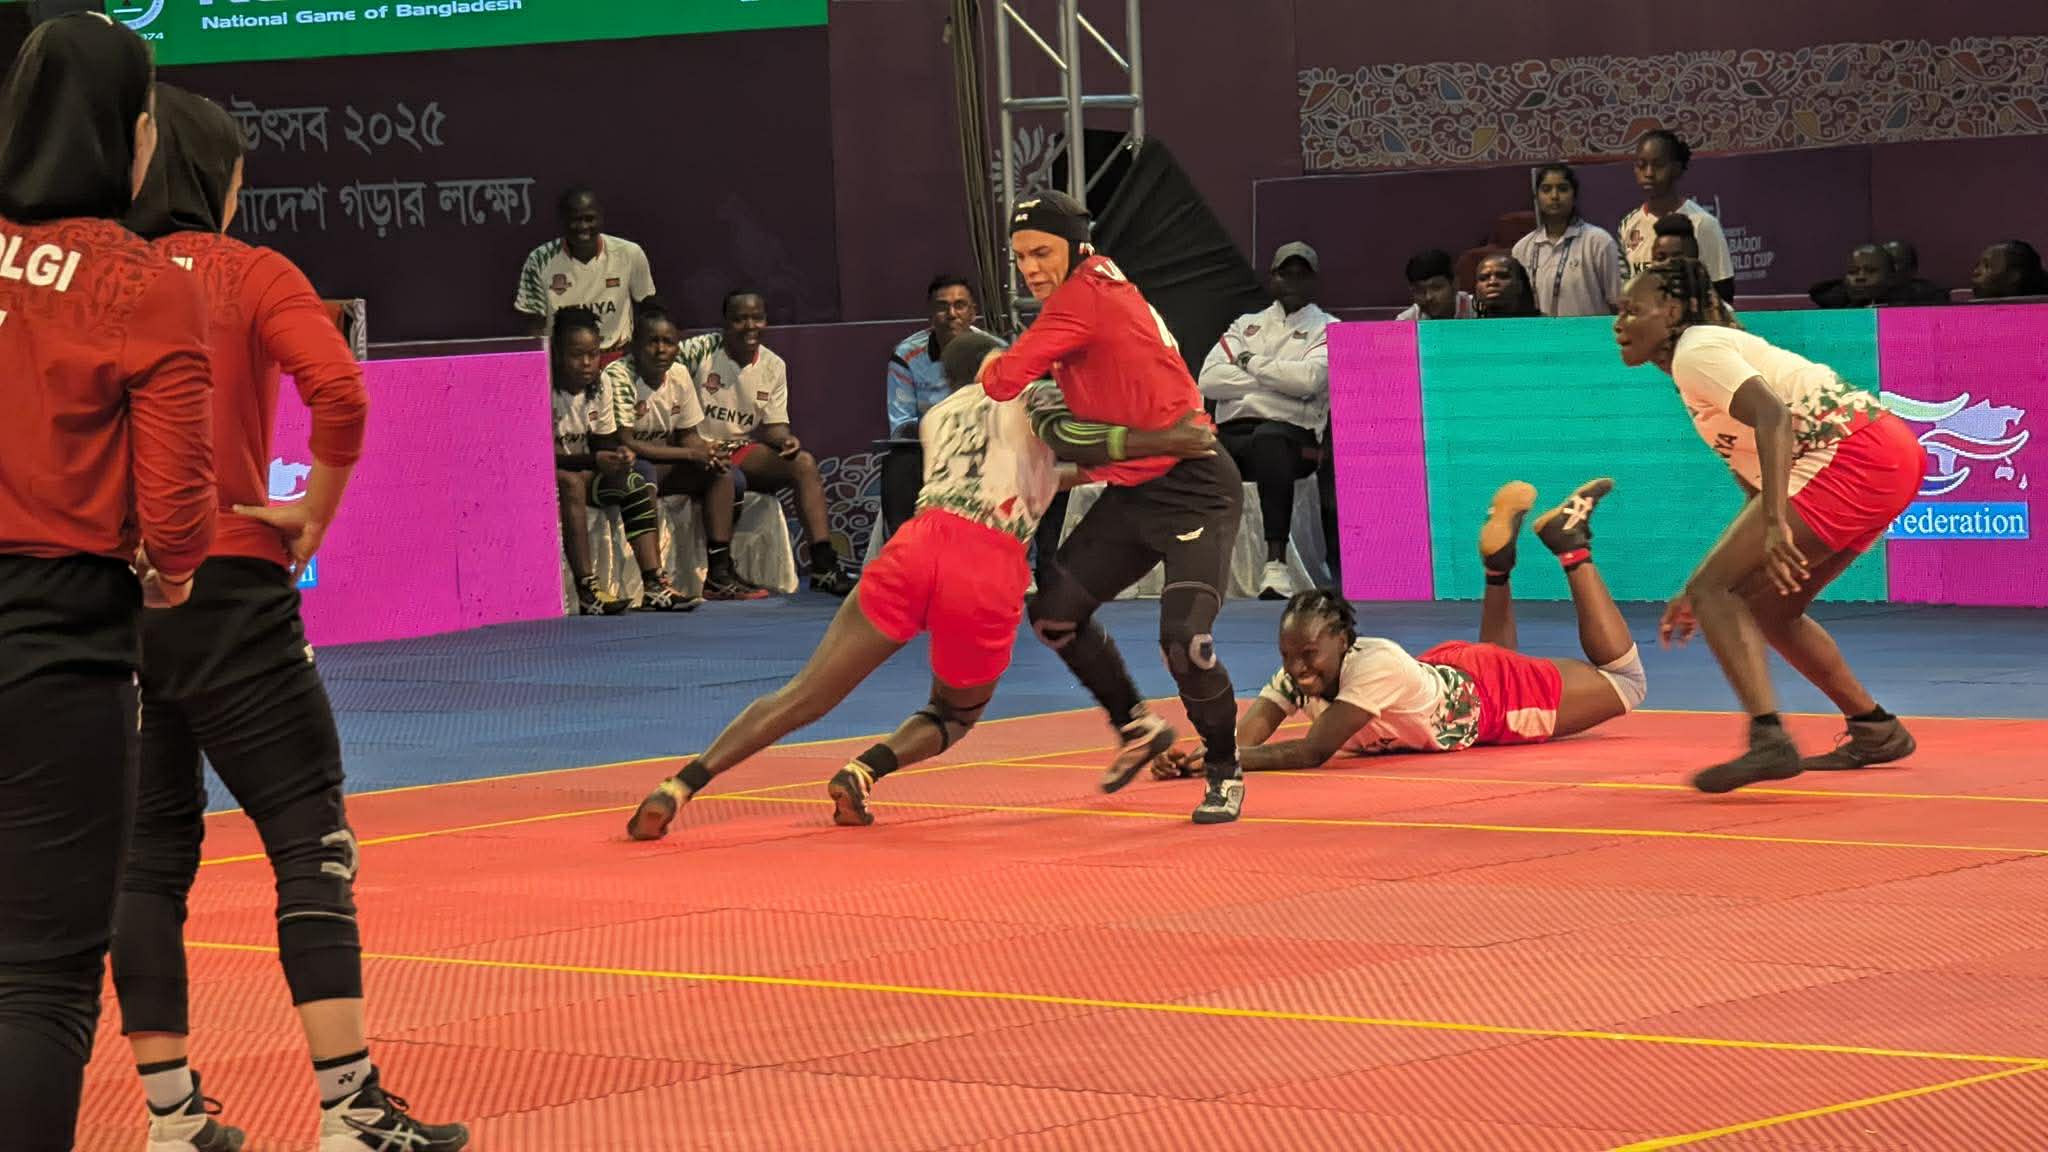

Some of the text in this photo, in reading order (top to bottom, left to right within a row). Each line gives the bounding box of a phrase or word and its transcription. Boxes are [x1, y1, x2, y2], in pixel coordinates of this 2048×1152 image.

[202, 0, 522, 29] National Game of Bangladesh
[344, 102, 446, 155] ২০২৫
[339, 177, 427, 238] গড়ার
[434, 177, 536, 227] লক্ষ্যে
[1727, 235, 1761, 254] BADDI
[1753, 250, 1774, 269] CUP
[704, 404, 756, 426] KENYA
